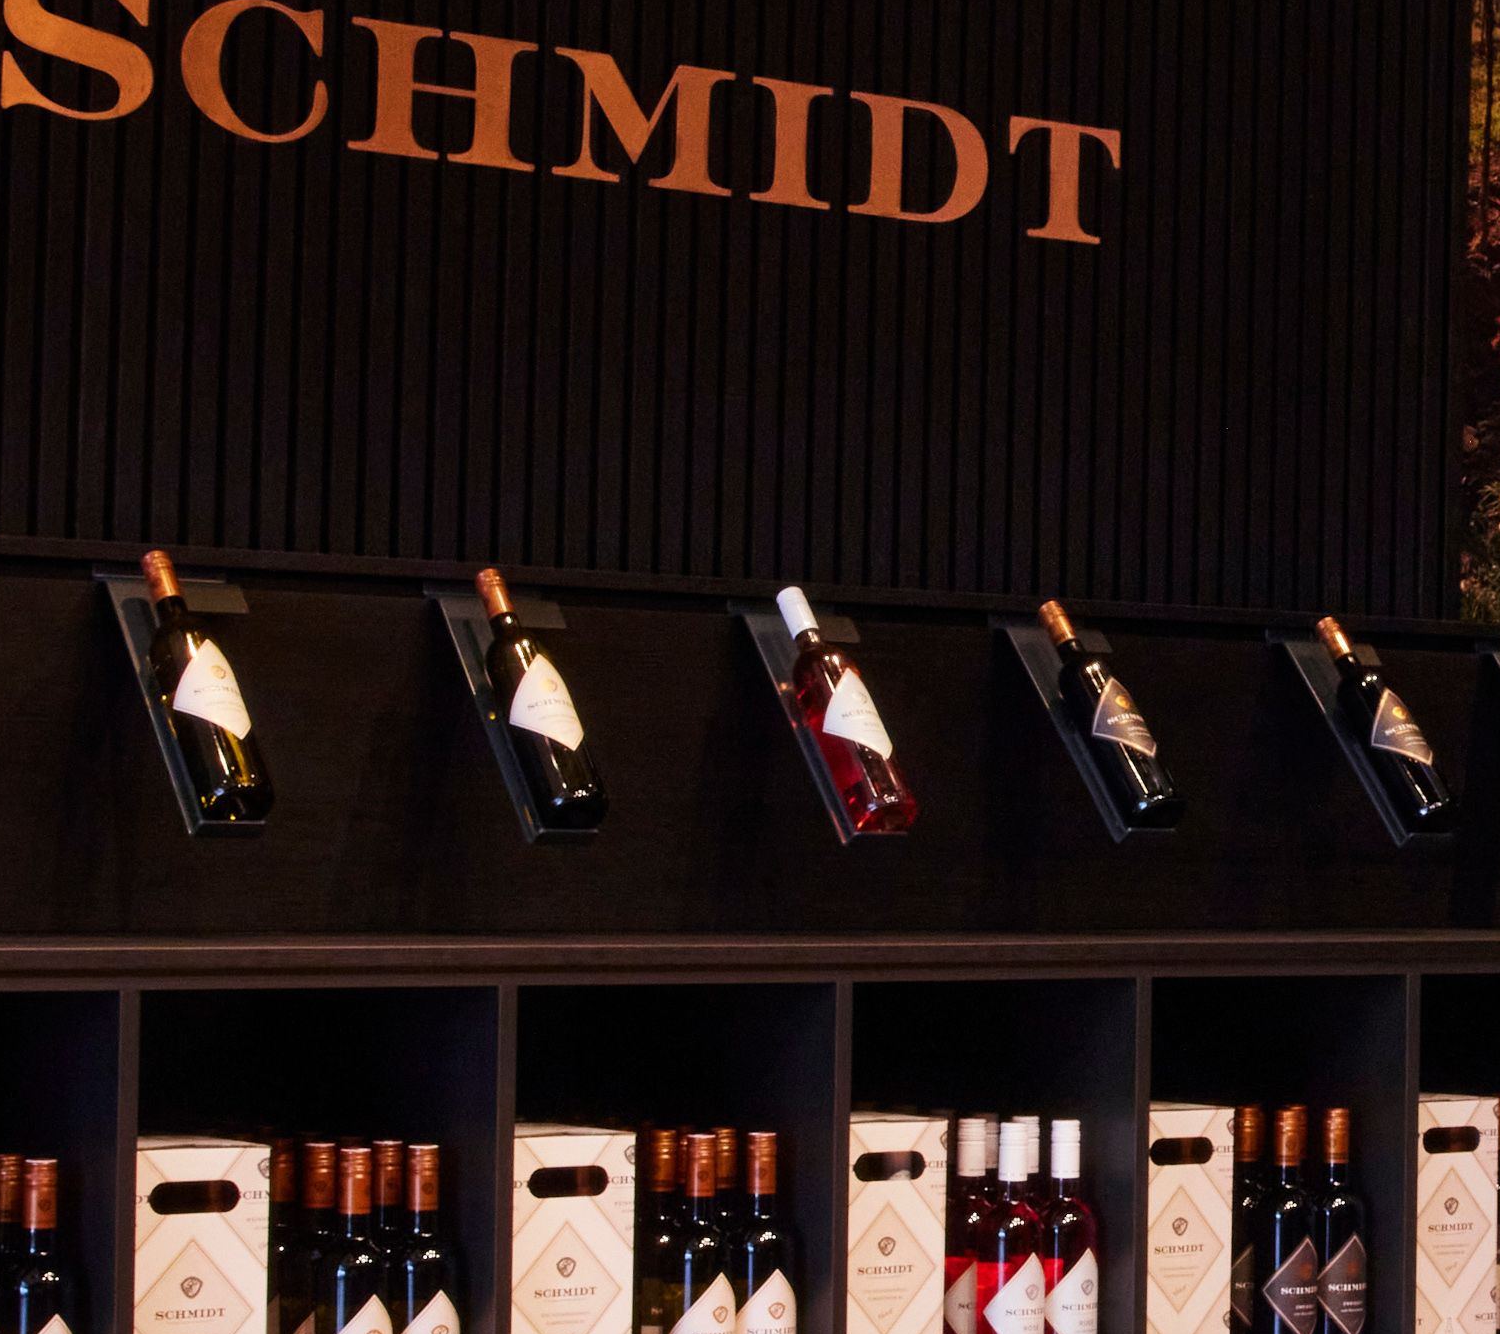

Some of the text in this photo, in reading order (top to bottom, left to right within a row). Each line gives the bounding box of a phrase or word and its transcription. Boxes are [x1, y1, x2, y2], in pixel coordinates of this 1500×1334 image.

[856, 1264, 915, 1276] SCHMIDT
[533, 1286, 597, 1300] SCHMIDT
[154, 1307, 225, 1321] SCHMIDT
